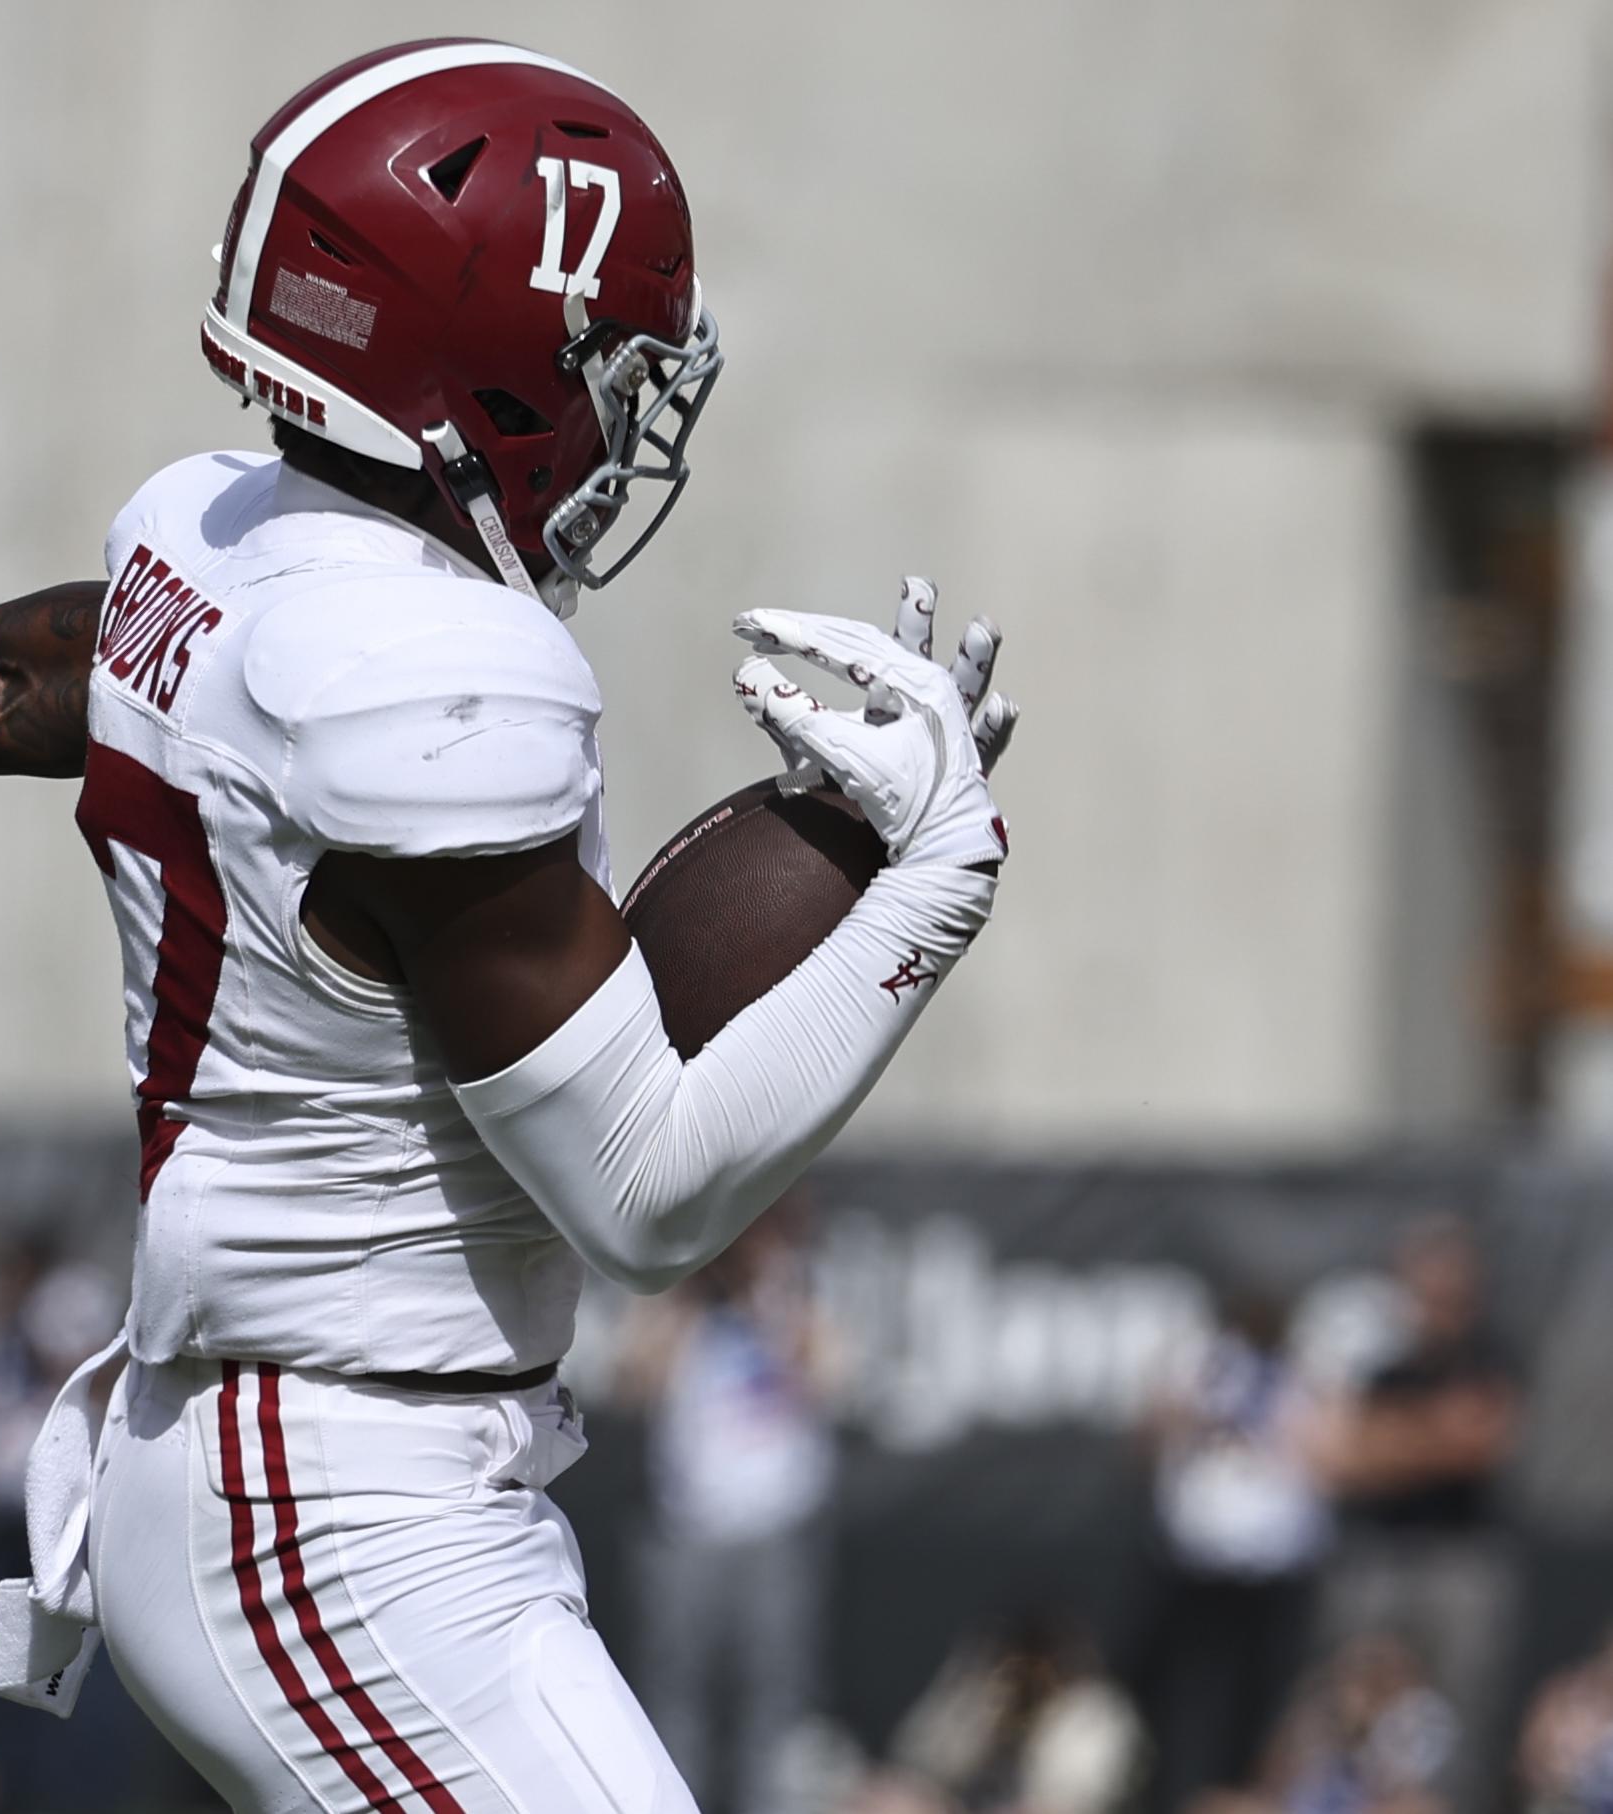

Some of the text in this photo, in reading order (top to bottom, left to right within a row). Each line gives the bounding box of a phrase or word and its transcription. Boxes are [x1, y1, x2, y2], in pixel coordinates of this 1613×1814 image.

[529, 156, 621, 300] 17
[305, 271, 348, 296] WARNING
[252, 368, 326, 427] TIDE
[479, 515, 520, 572] CRIMSON
[98, 543, 223, 715] BROOKS
